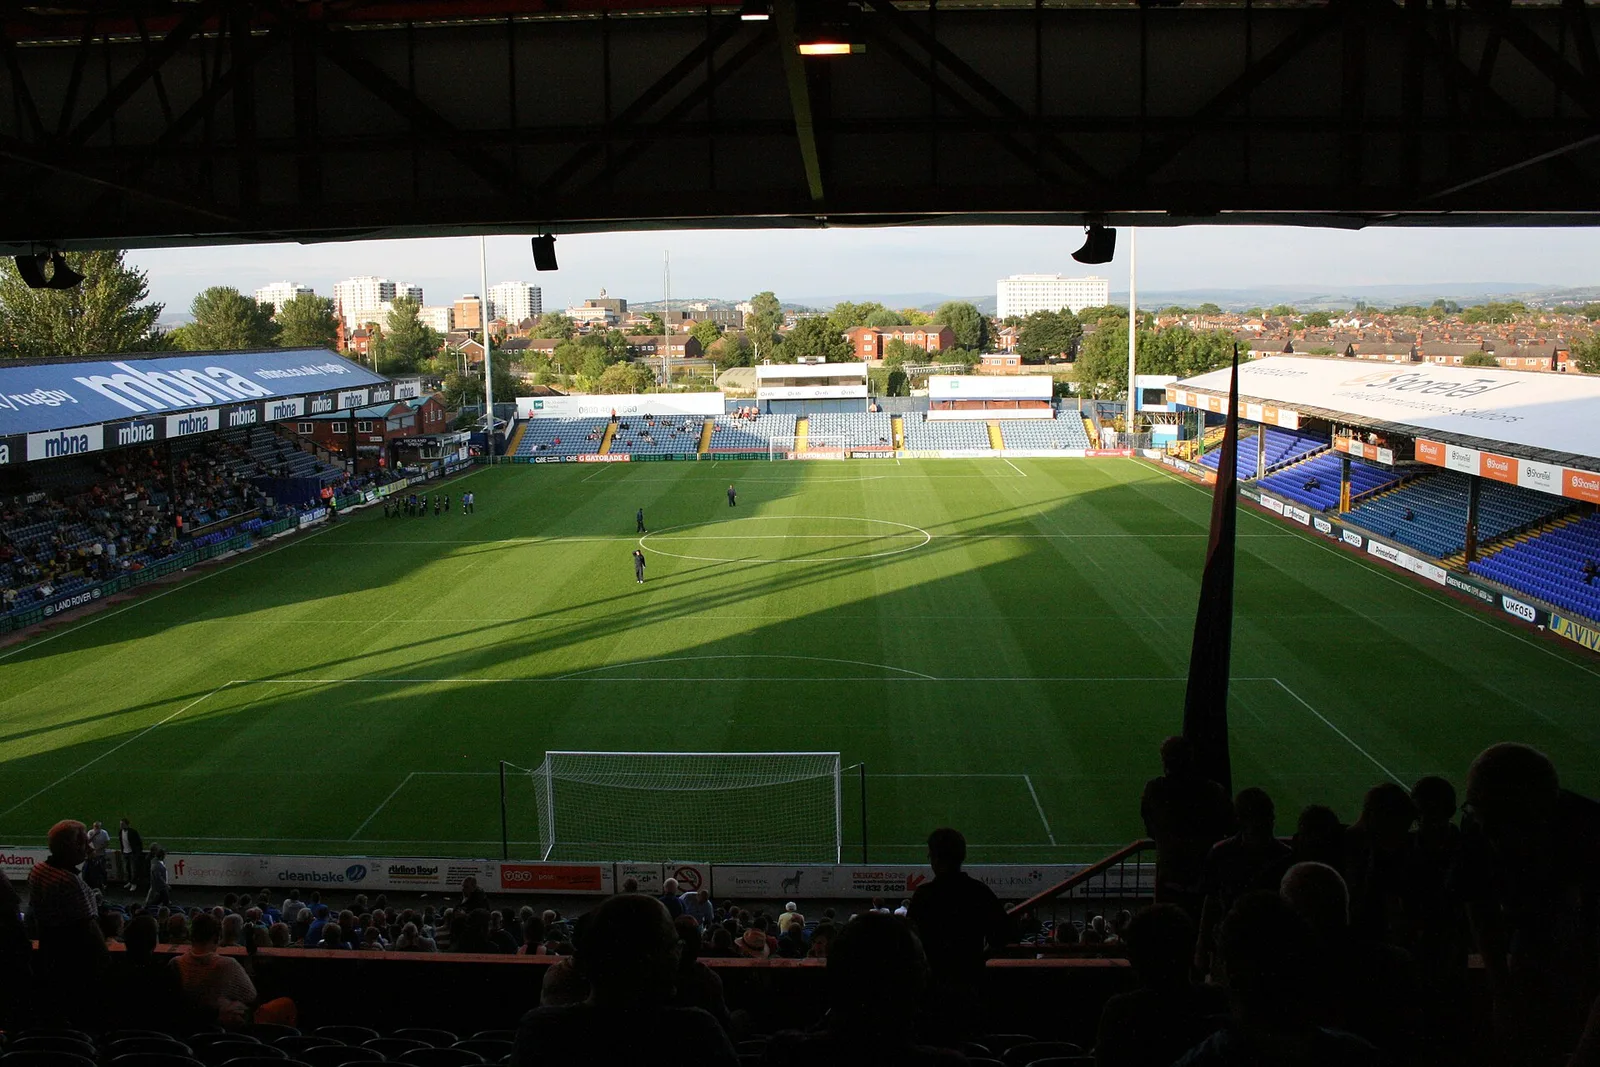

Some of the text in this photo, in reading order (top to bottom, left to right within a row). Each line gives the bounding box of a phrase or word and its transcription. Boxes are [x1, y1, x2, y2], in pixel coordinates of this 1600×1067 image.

[73, 361, 275, 412] mbna
[373, 387, 390, 402] mbna
[399, 384, 414, 398] mbna
[1366, 373, 1521, 398] ShoreTel
[311, 395, 332, 413] mbna
[344, 391, 363, 409] mbna
[230, 406, 257, 427] mbna
[274, 401, 297, 420] mbna
[119, 421, 155, 445] mbna
[178, 413, 209, 435] mbna
[45, 432, 89, 457] mbna
[1531, 468, 1551, 480] ShoreTel
[1577, 478, 1600, 491] ShoreTel
[54, 592, 91, 612] LAND ROVER
[1564, 621, 1600, 650] AVIV
[0, 854, 34, 865] Adam
[278, 870, 344, 882] cleanbake
[417, 865, 438, 875] lloyd
[505, 871, 531, 881] TNT
